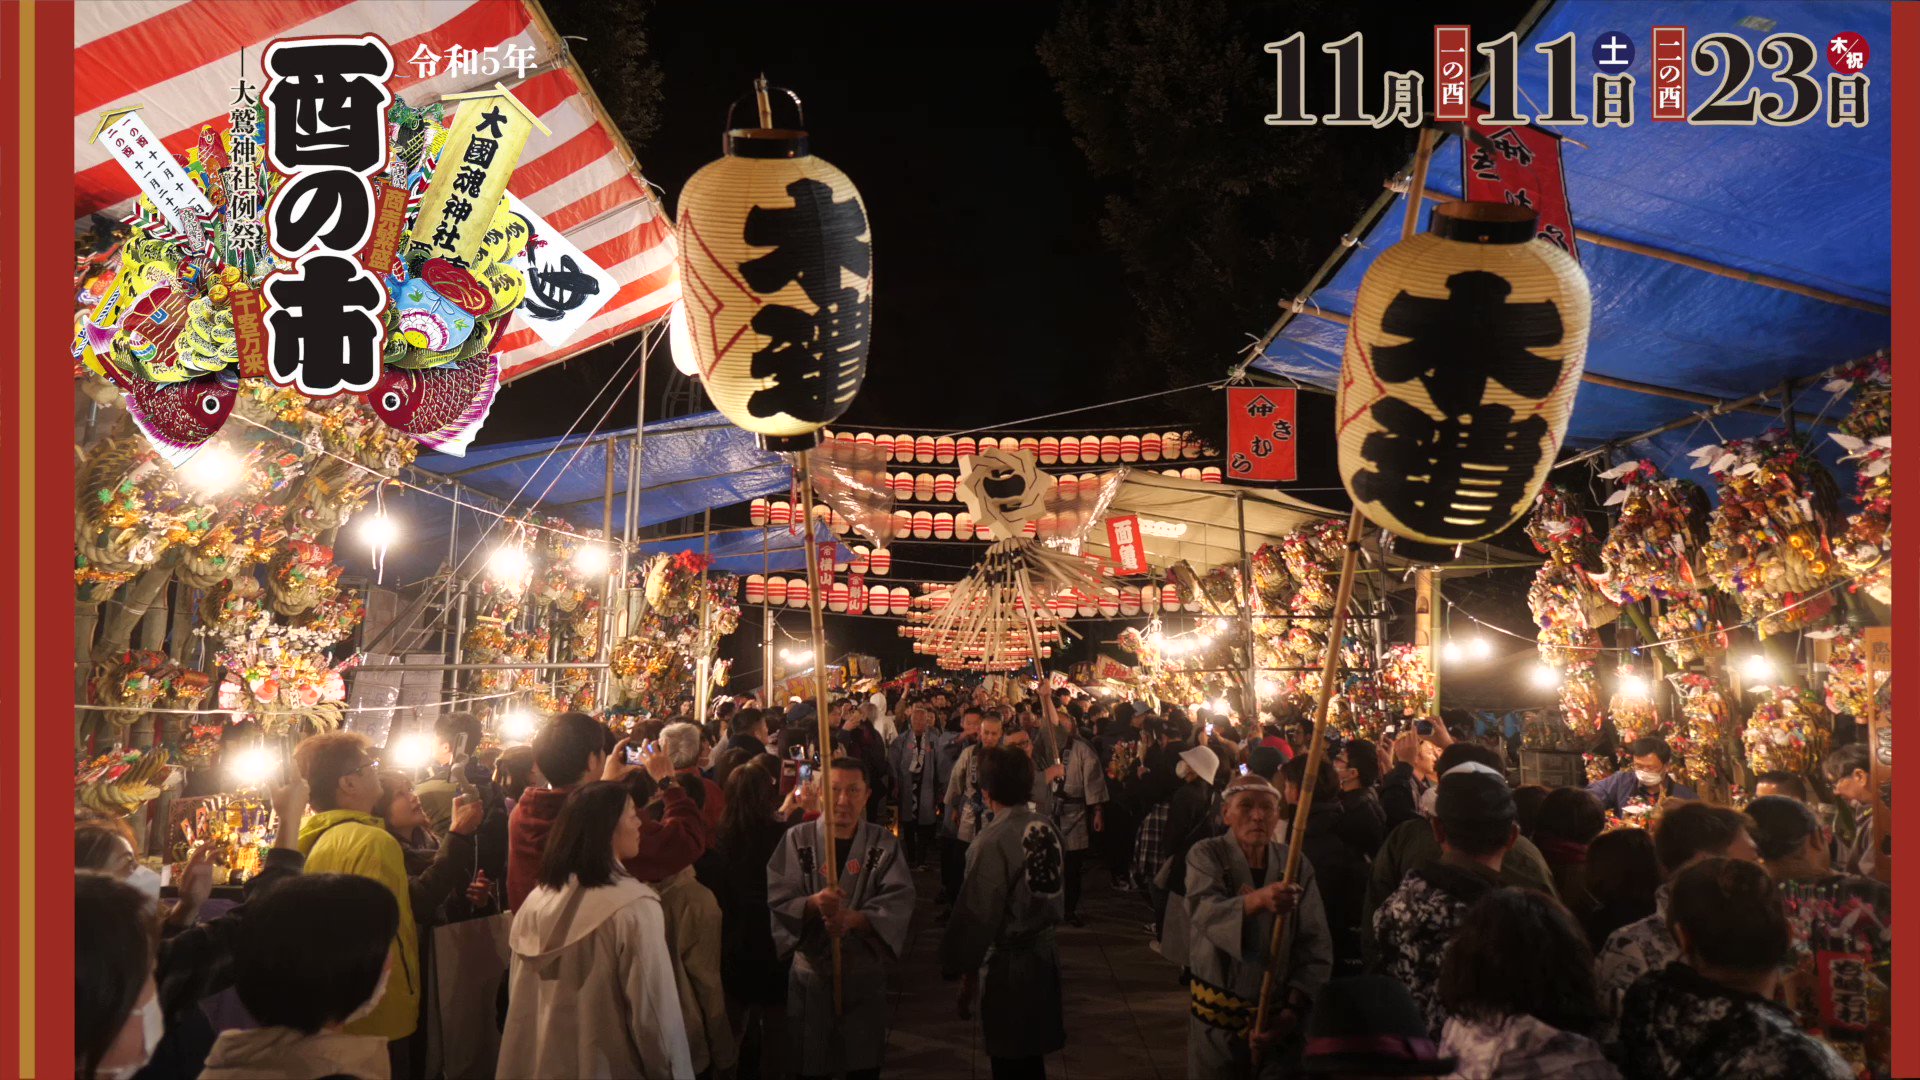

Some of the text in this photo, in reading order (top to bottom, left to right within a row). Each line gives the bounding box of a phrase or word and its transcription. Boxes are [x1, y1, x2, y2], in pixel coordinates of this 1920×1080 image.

[432, 106, 508, 253] 大國魂神社
